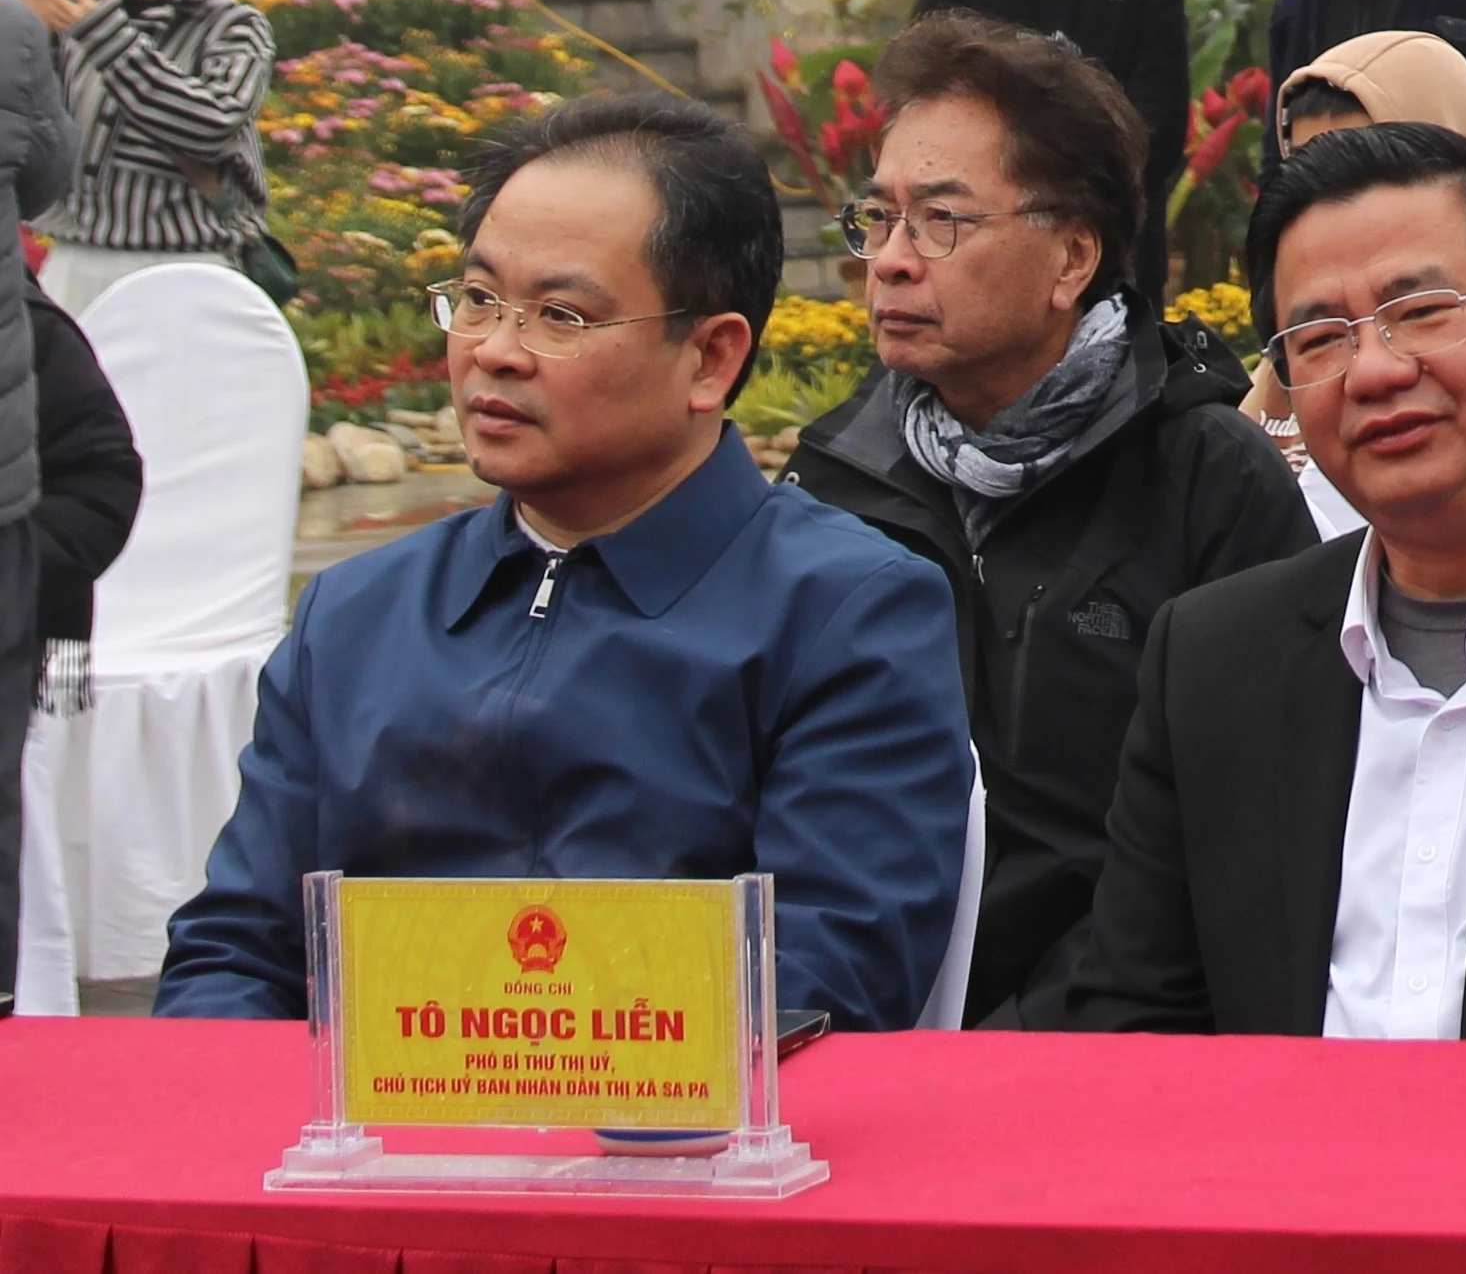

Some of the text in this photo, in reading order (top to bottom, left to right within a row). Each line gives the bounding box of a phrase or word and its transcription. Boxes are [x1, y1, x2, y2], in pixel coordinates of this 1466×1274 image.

[548, 981, 572, 995] CHÍ
[395, 997, 686, 1046] TÔ NGỌC LIỄN
[465, 1051, 498, 1070] PHÓ
[503, 1051, 519, 1070] BÍ
[524, 1054, 555, 1070] THƯ
[560, 1054, 584, 1074] THỊ
[373, 1072, 405, 1093] CHỦ
[410, 1076, 446, 1097] TỊCH
[477, 1077, 510, 1095] BAN
[515, 1076, 561, 1096] NHÂN
[566, 1077, 600, 1097] DÂN
[605, 1079, 630, 1100] THỊ
[635, 1077, 657, 1098] XÃ
[662, 1080, 683, 1098] SA
[688, 1081, 709, 1099] PA
